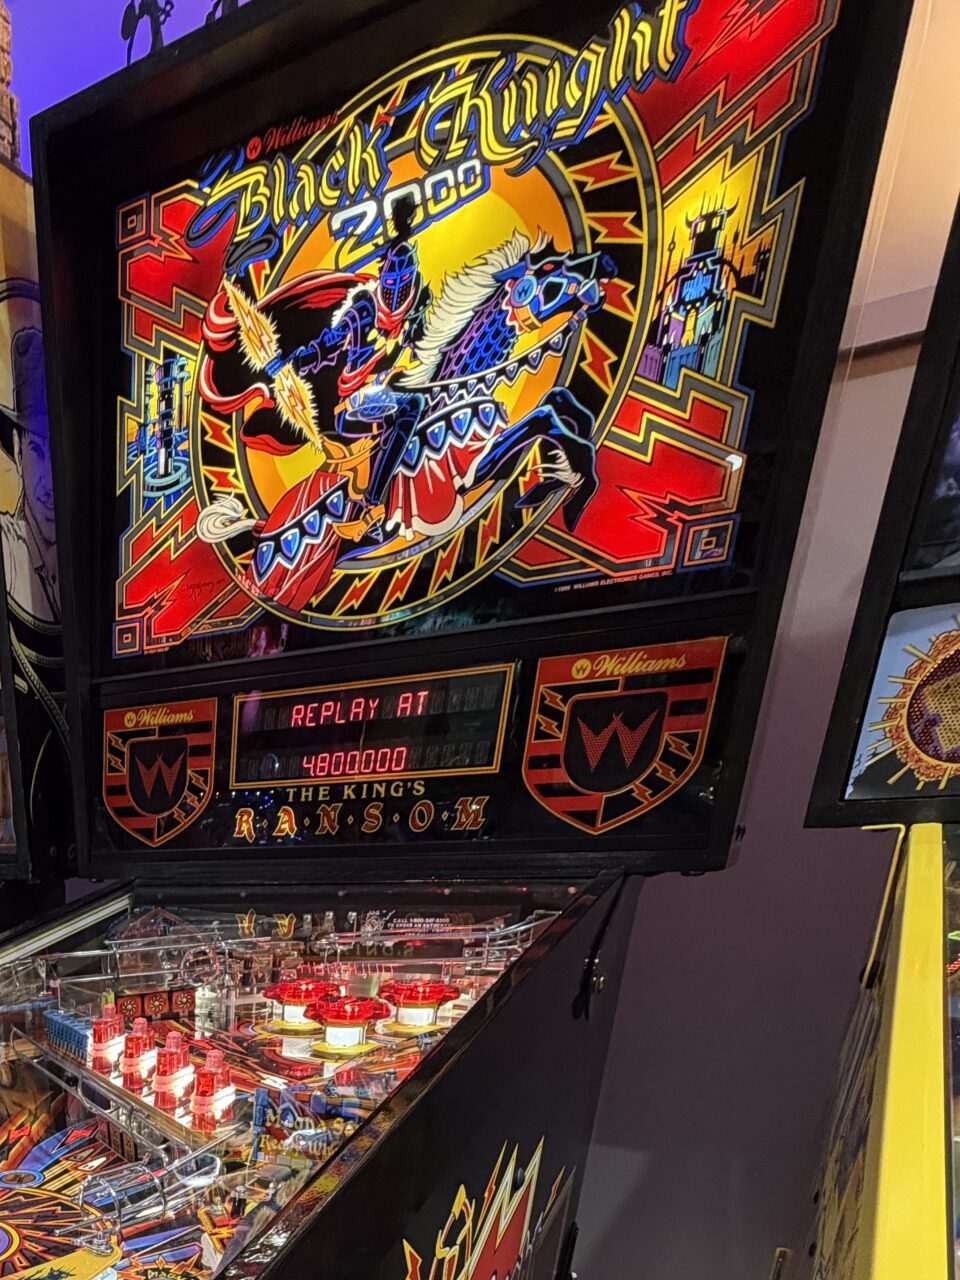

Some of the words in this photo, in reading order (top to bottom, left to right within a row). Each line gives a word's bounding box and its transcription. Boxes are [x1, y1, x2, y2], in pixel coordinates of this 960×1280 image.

[198, 120, 391, 258] Black
[412, 0, 698, 174] Knight
[331, 158, 490, 270] 2000
[593, 651, 687, 678] Williams
[136, 708, 194, 728] Williams
[291, 698, 380, 729] REPLAY
[397, 690, 429, 716] AT
[303, 747, 408, 777] 4800000
[287, 786, 330, 803] THE
[342, 780, 426, 801] KING'S
